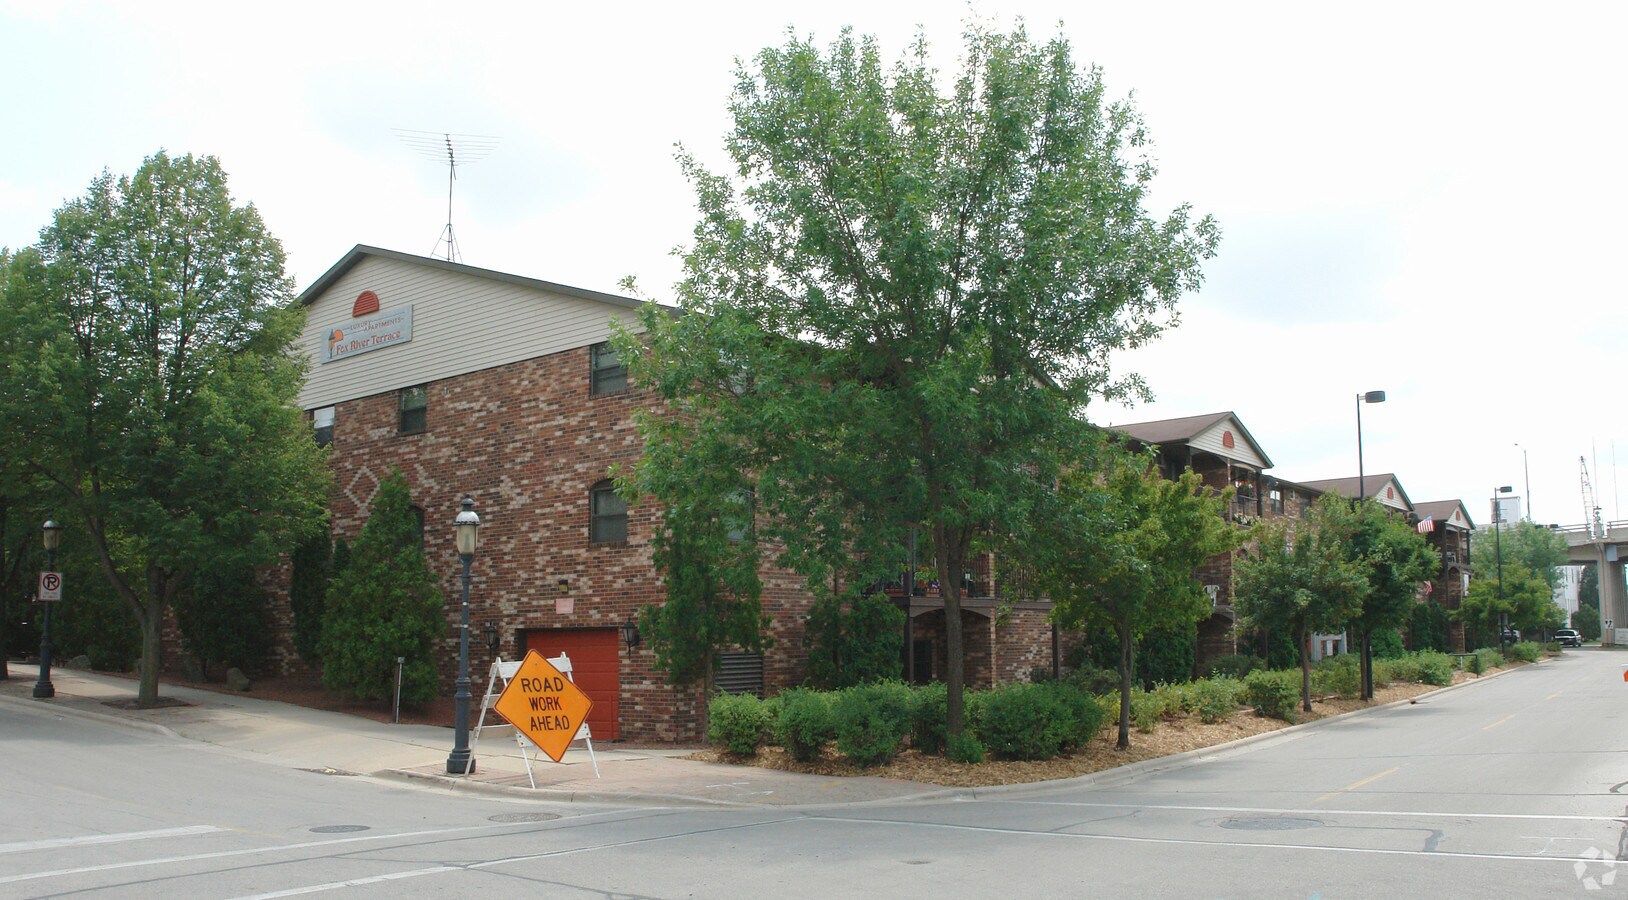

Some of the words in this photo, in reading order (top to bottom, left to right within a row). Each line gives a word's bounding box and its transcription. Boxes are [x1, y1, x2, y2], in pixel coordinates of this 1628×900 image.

[364, 317, 401, 332] APARTMENTS
[336, 344, 349, 355] Fox
[350, 338, 370, 351] River
[371, 330, 401, 344] Terrace
[521, 677, 564, 692] ROAD
[529, 697, 562, 711] WORK
[530, 715, 570, 731] AHEAD
